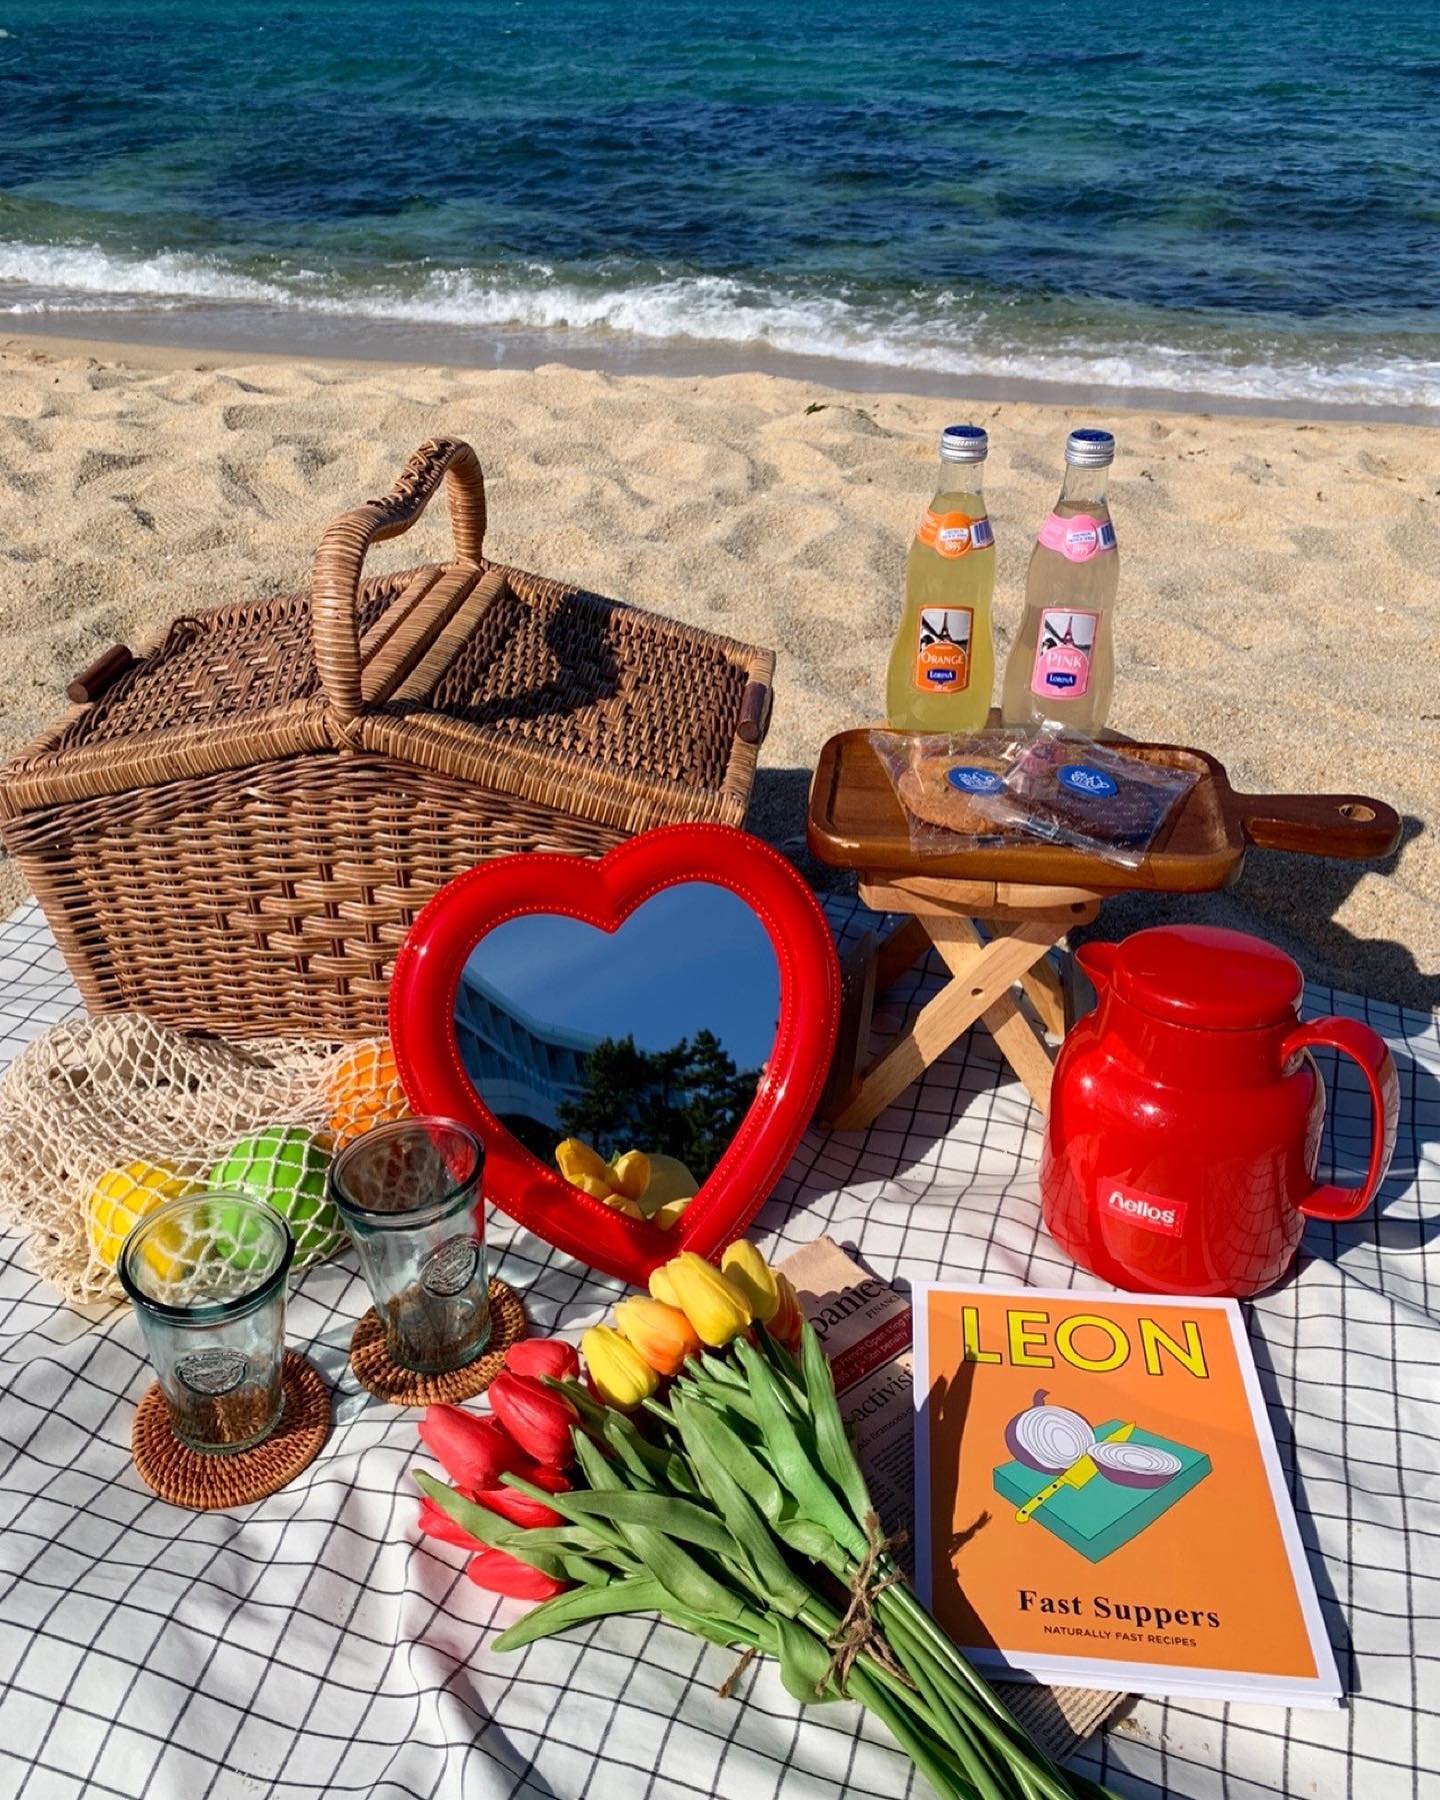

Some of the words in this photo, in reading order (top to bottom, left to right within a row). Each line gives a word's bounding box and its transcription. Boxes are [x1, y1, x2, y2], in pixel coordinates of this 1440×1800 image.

[920, 651, 964, 665] ORANGE
[1047, 652, 1082, 668] PINK
[962, 1306, 1209, 1379] LEON
[851, 1362, 913, 1421] activist
[1018, 1590, 1082, 1615] Fast
[1094, 1596, 1220, 1629] Suppers
[1044, 1625, 1111, 1640] NATURALLY
[1115, 1631, 1144, 1642] FAST
[1148, 1635, 1197, 1647] RECIPES
